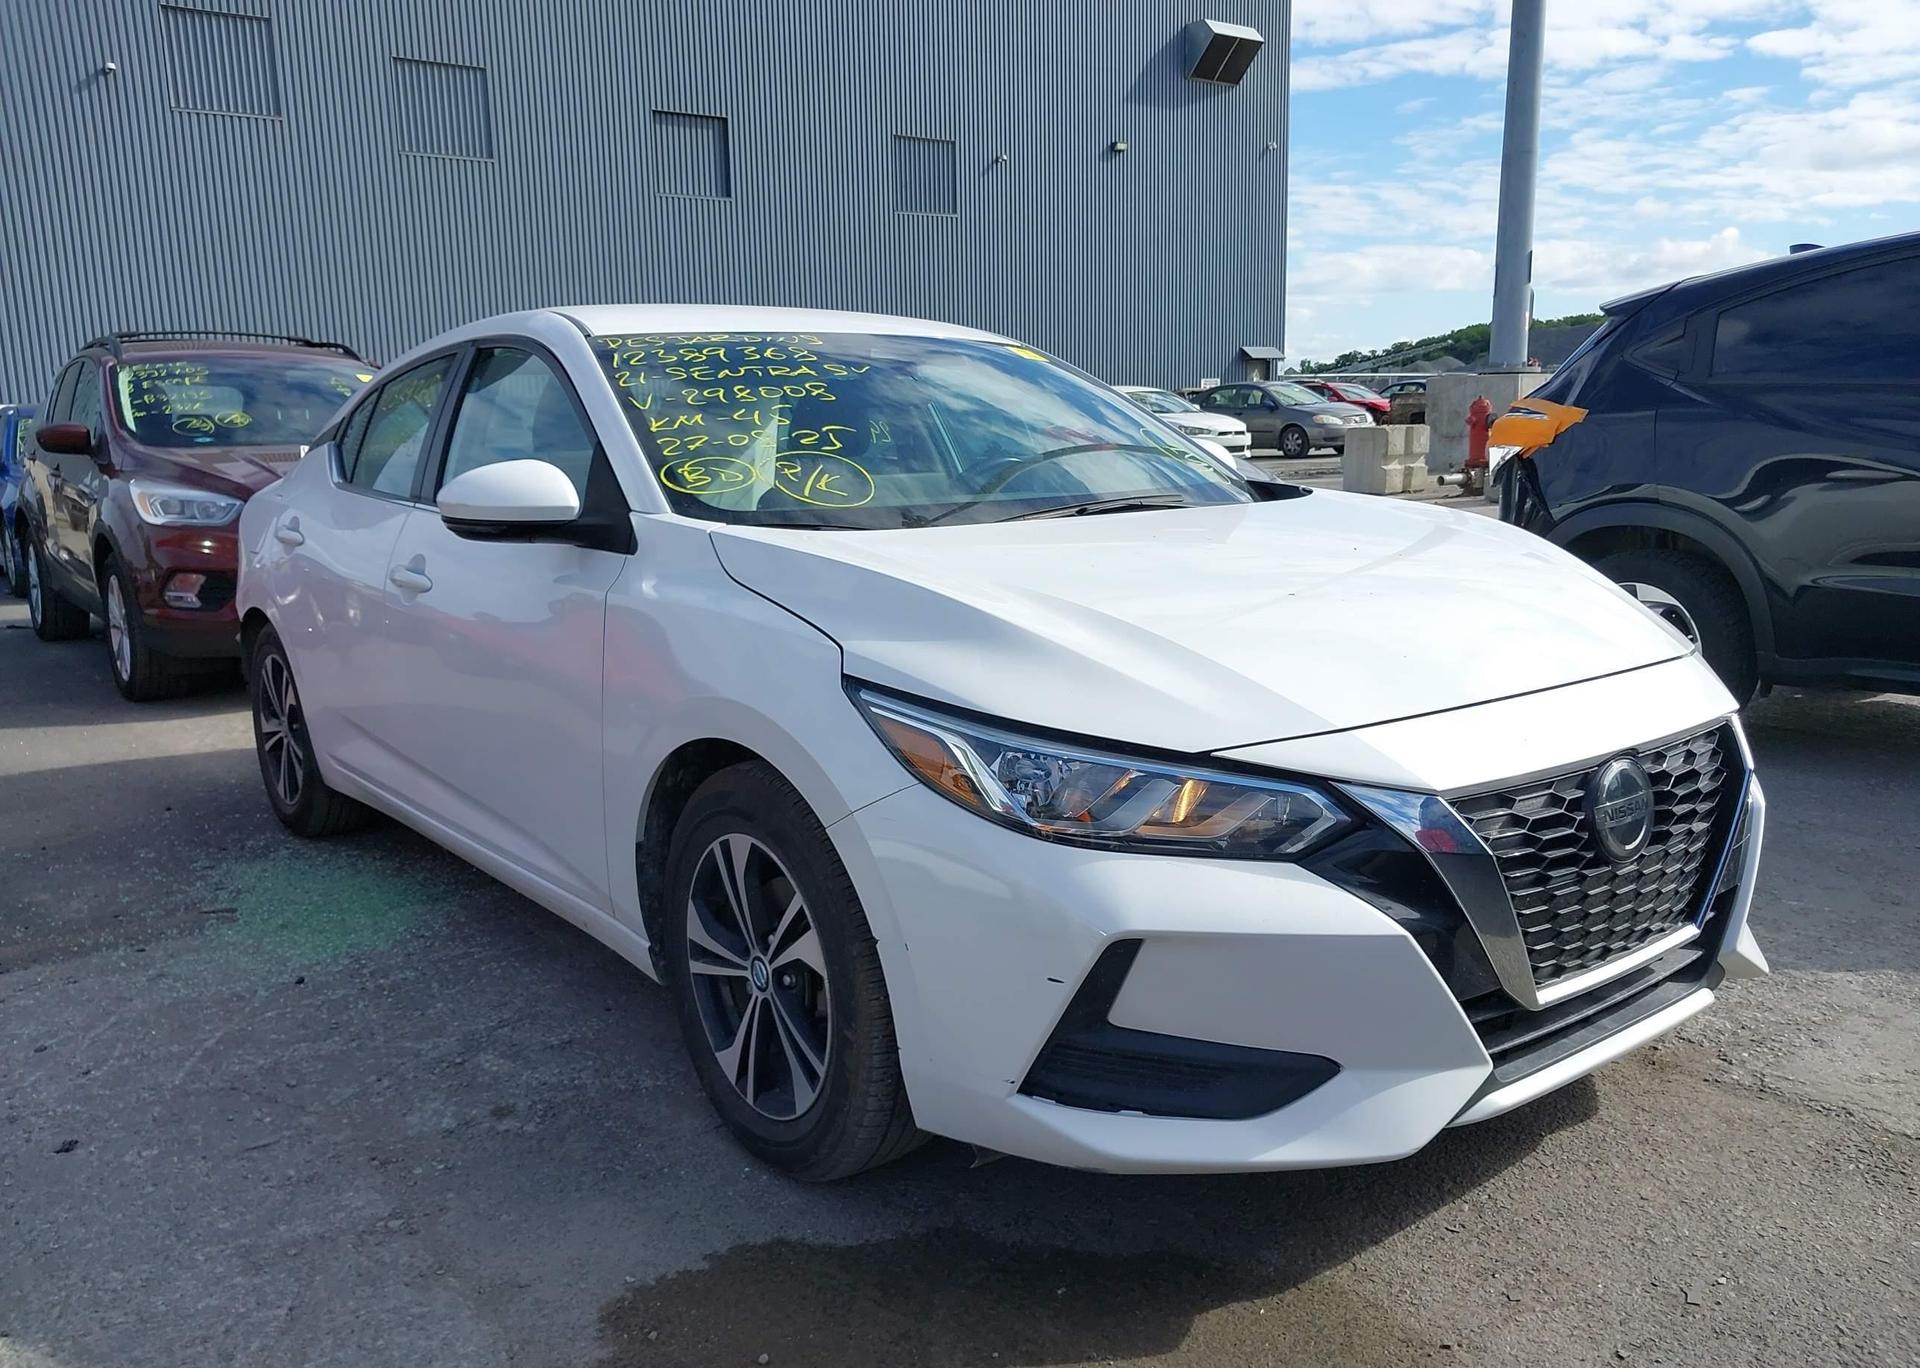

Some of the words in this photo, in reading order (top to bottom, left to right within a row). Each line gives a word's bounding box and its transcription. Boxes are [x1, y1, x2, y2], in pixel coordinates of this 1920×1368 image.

[612, 346, 818, 368] 12389368
[823, 363, 871, 376] SV
[1603, 797, 1649, 823] NISSAN
